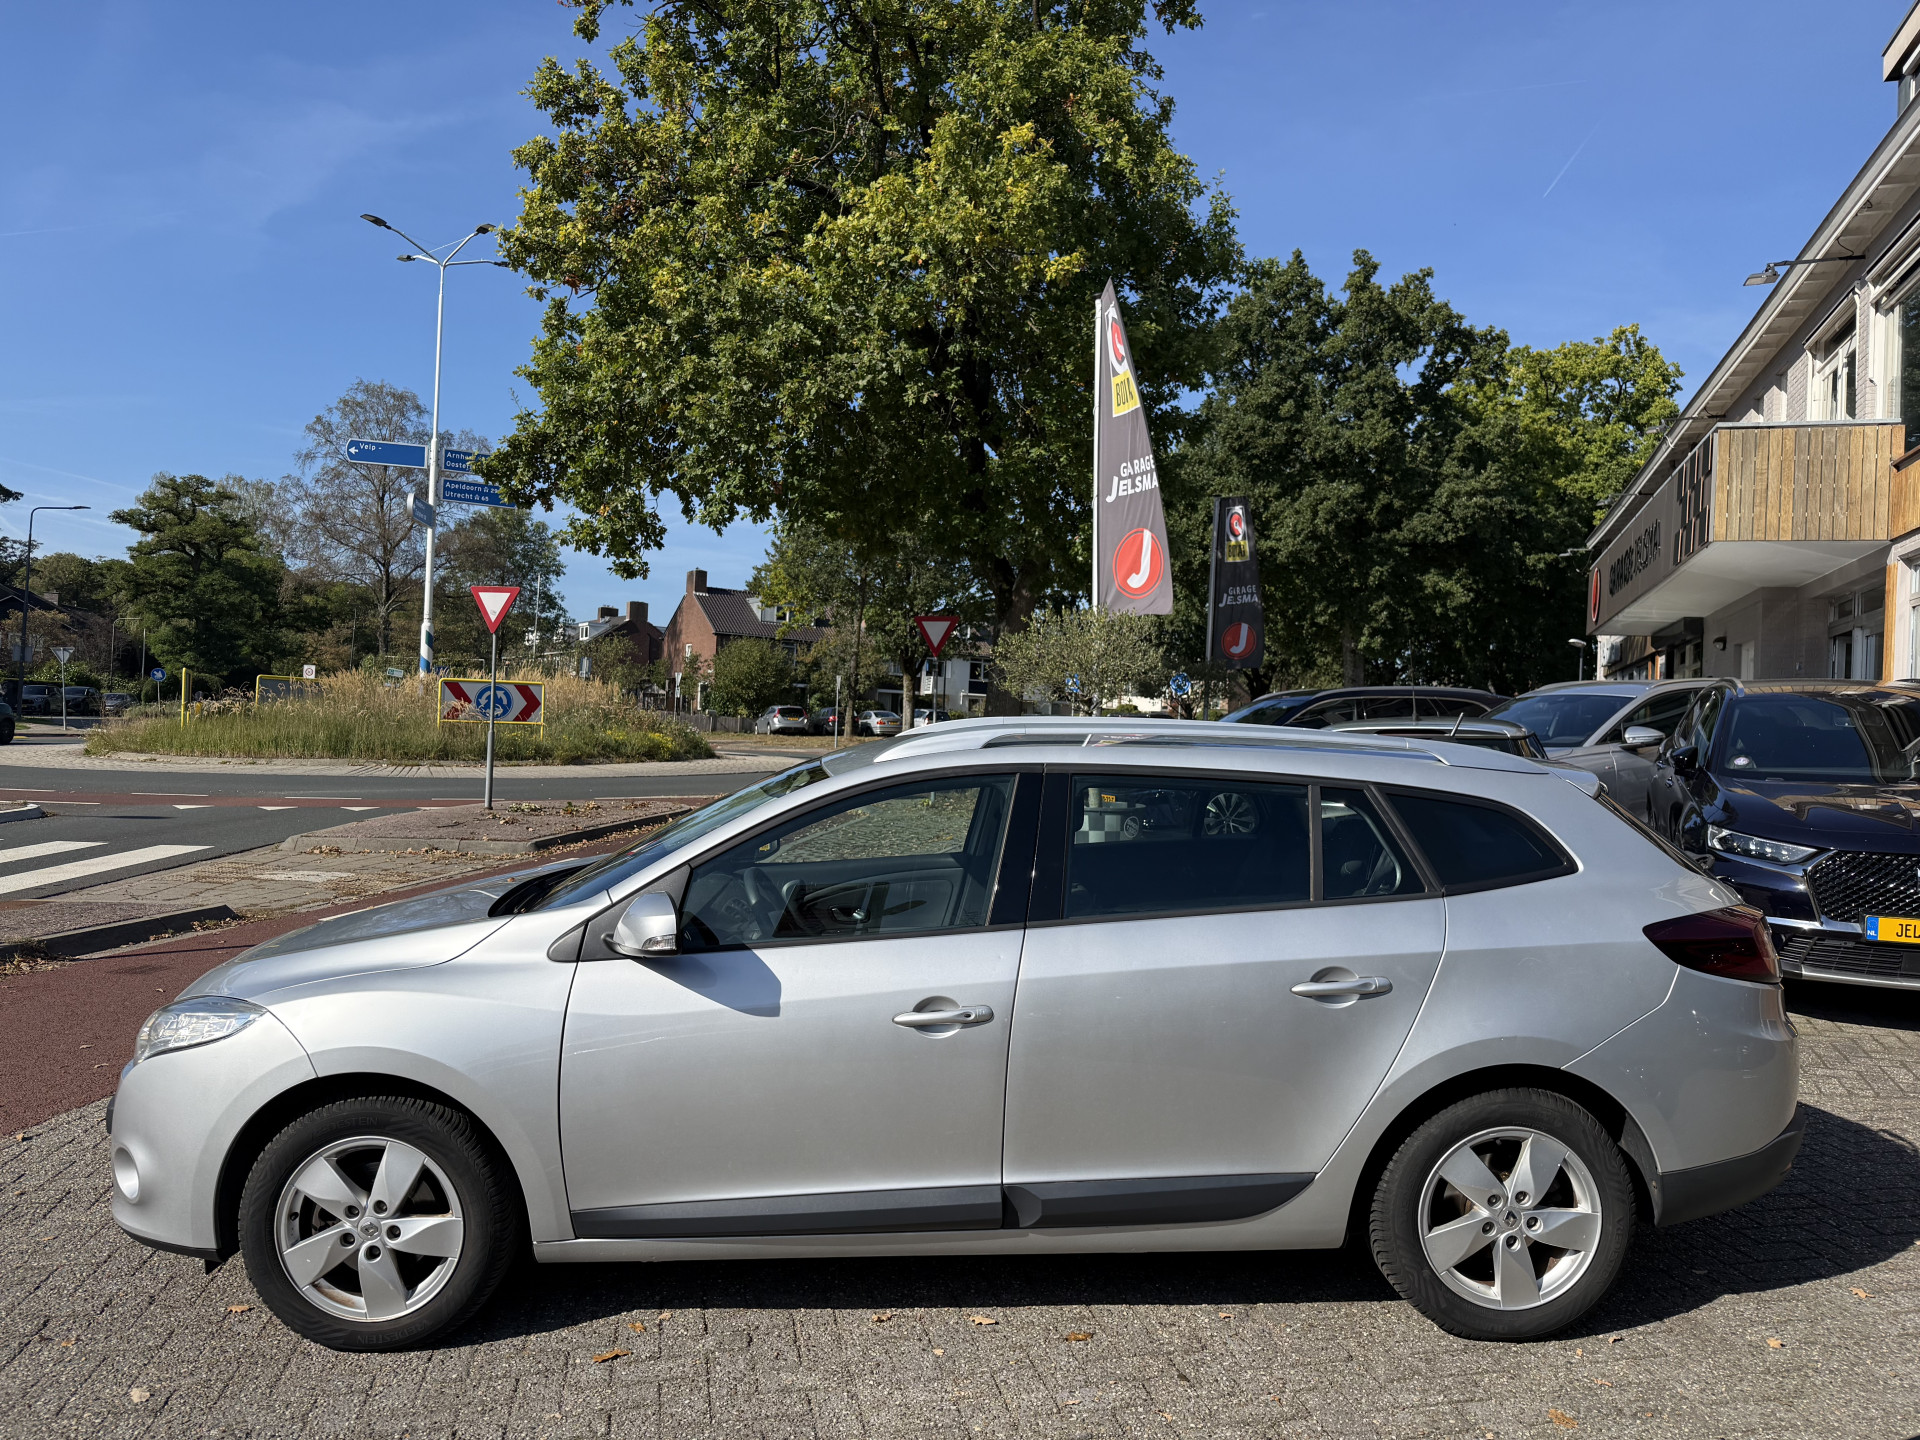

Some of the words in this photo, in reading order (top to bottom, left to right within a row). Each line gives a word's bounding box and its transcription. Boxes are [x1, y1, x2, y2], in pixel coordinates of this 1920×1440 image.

[359, 442, 376, 451] Velp
[446, 451, 474, 460] Arnh
[1120, 454, 1156, 477] GARAGE
[445, 482, 482, 492] Apeldoorn
[1105, 471, 1159, 503] JELSMA
[445, 491, 473, 500] Utrecht
[1218, 593, 1259, 608] JELSMA
[1896, 923, 1920, 938] JEL
